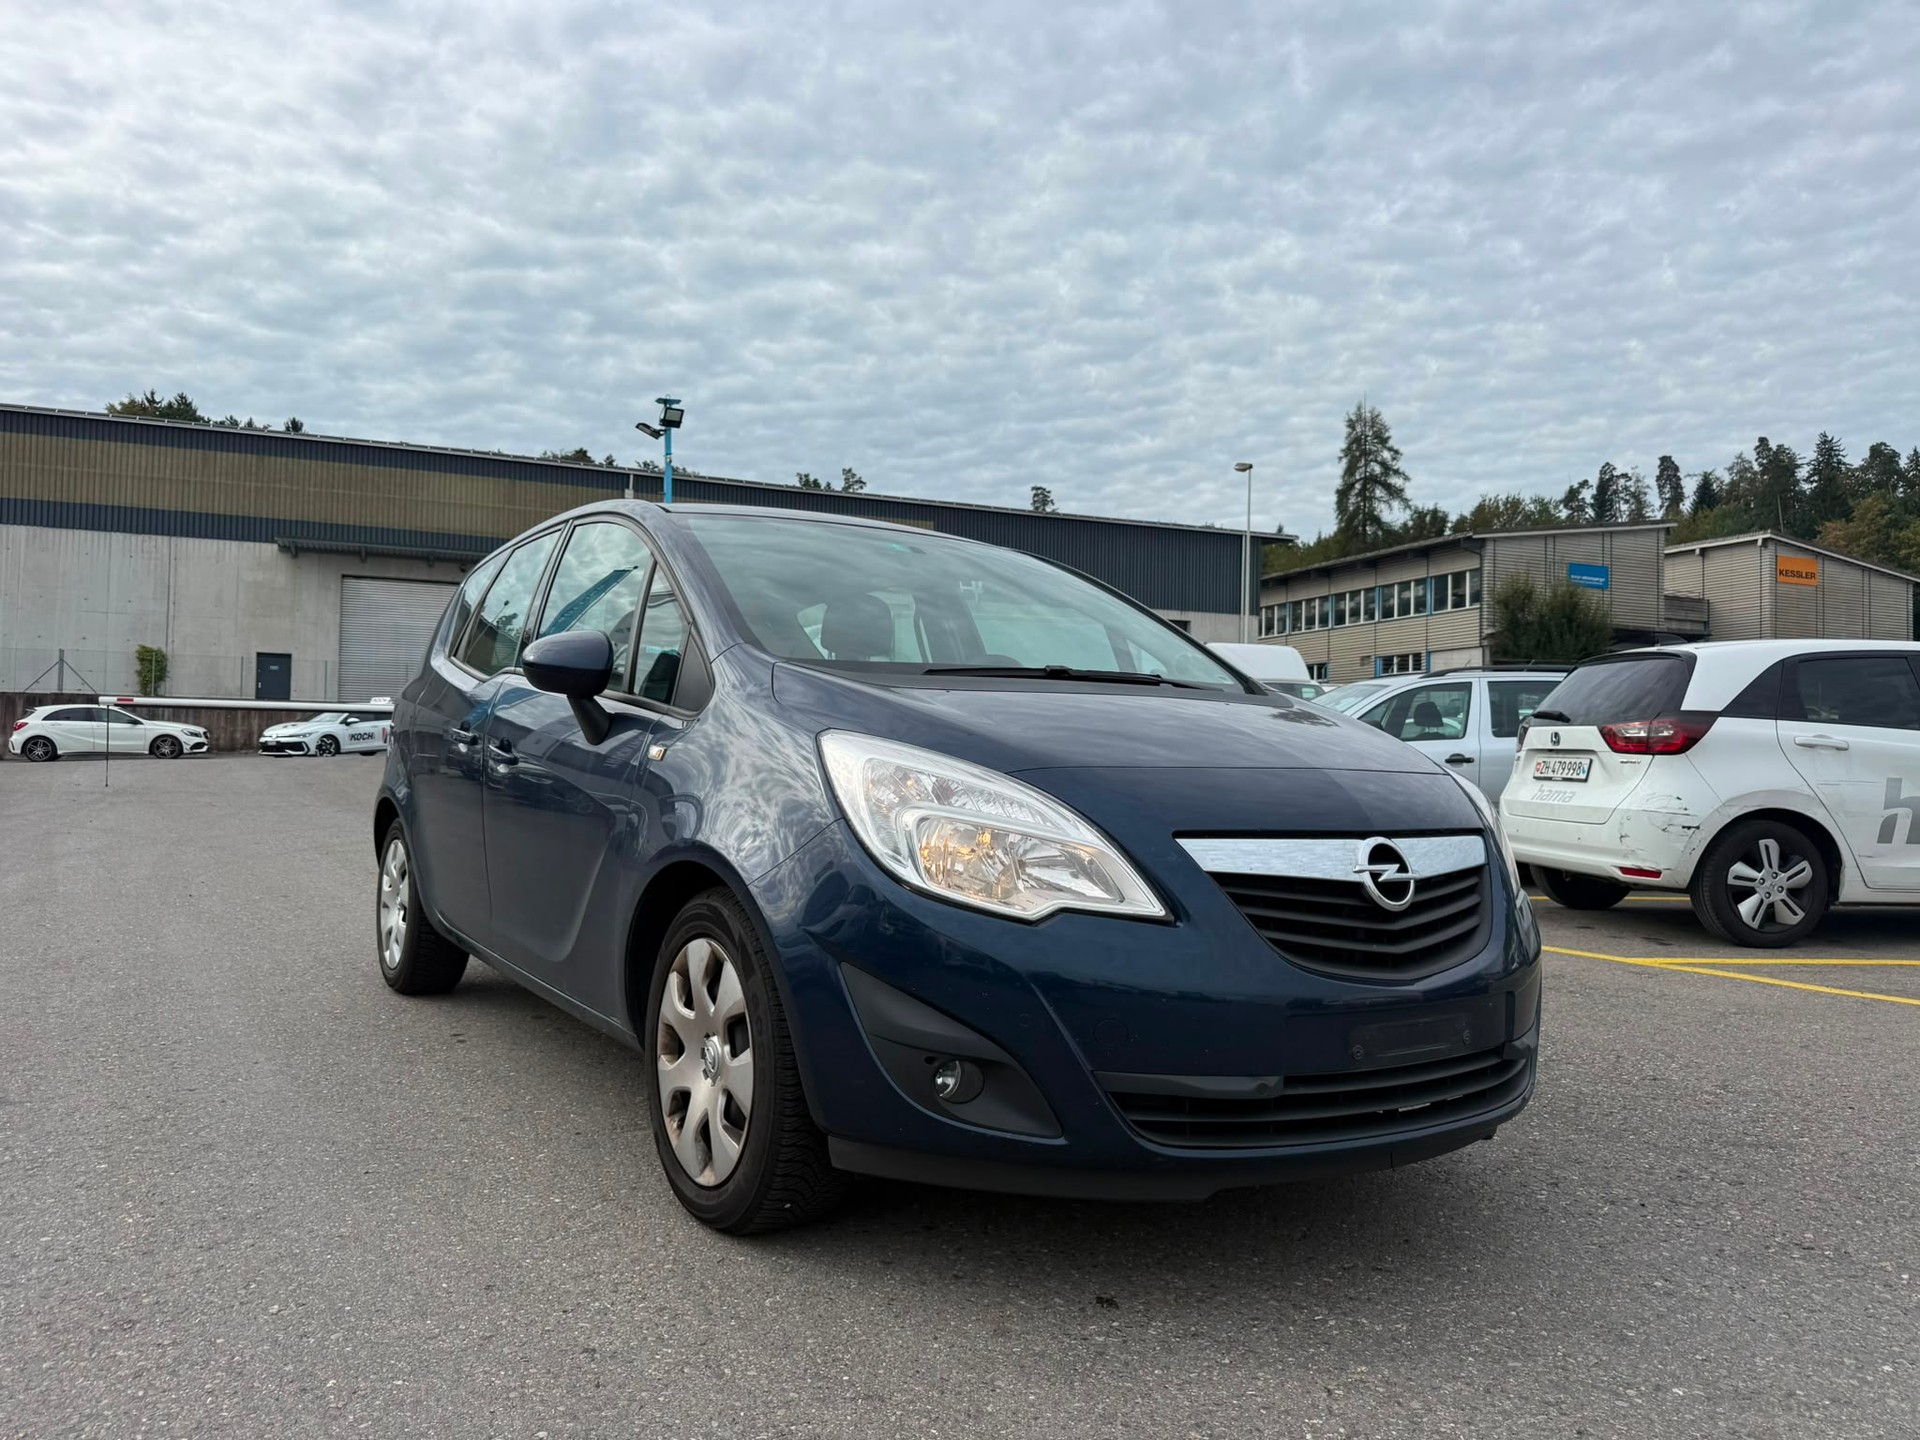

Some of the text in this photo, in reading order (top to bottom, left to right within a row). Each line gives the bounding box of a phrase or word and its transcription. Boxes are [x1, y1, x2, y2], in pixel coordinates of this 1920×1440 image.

[1779, 569, 1816, 580] KESSLER
[350, 732, 375, 741] KOCH
[1531, 784, 1577, 803] hama
